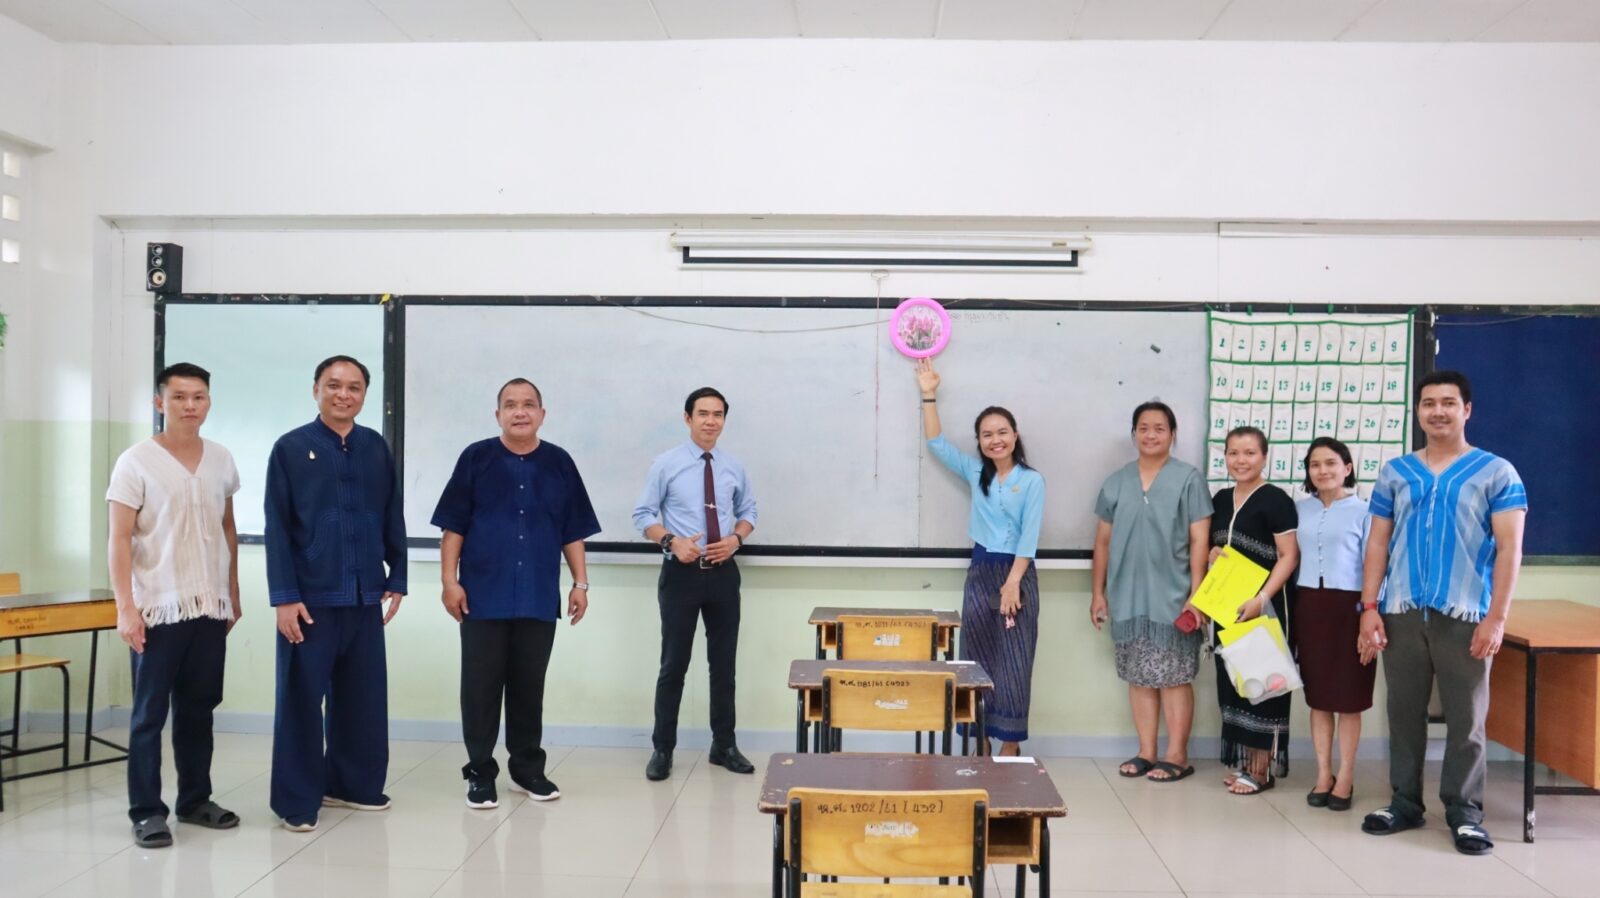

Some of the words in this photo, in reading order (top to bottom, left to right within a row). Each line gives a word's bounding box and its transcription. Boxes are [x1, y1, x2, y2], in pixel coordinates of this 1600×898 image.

[1219, 338, 1225, 348] 1
[1238, 339, 1245, 350] 2
[1259, 340, 1267, 351] 3
[1280, 340, 1287, 351] 4
[1304, 340, 1312, 352] 5
[1326, 341, 1333, 351] 6
[1349, 340, 1356, 352] 7
[1370, 341, 1377, 353] 8
[1391, 340, 1397, 352] 9
[1216, 376, 1227, 387] 10
[1235, 378, 1244, 389] 11
[1256, 380, 1268, 390] 12
[1278, 380, 1289, 391] 13
[1299, 381, 1312, 392] 14
[1321, 381, 1332, 392] 15
[1344, 382, 1356, 393] 16
[1366, 382, 1375, 391] 17
[1387, 380, 1397, 391] 18
[1214, 418, 1225, 428] 19
[1234, 418, 1246, 428] 20
[1254, 419, 1266, 430] 21
[1275, 420, 1287, 430] 22
[1297, 421, 1309, 431] 23
[1318, 419, 1331, 430] 24
[1344, 419, 1356, 429] 25
[1364, 418, 1376, 428] 26
[1387, 418, 1400, 429] 27
[1275, 459, 1286, 471] 31
[1363, 459, 1379, 471] 35
